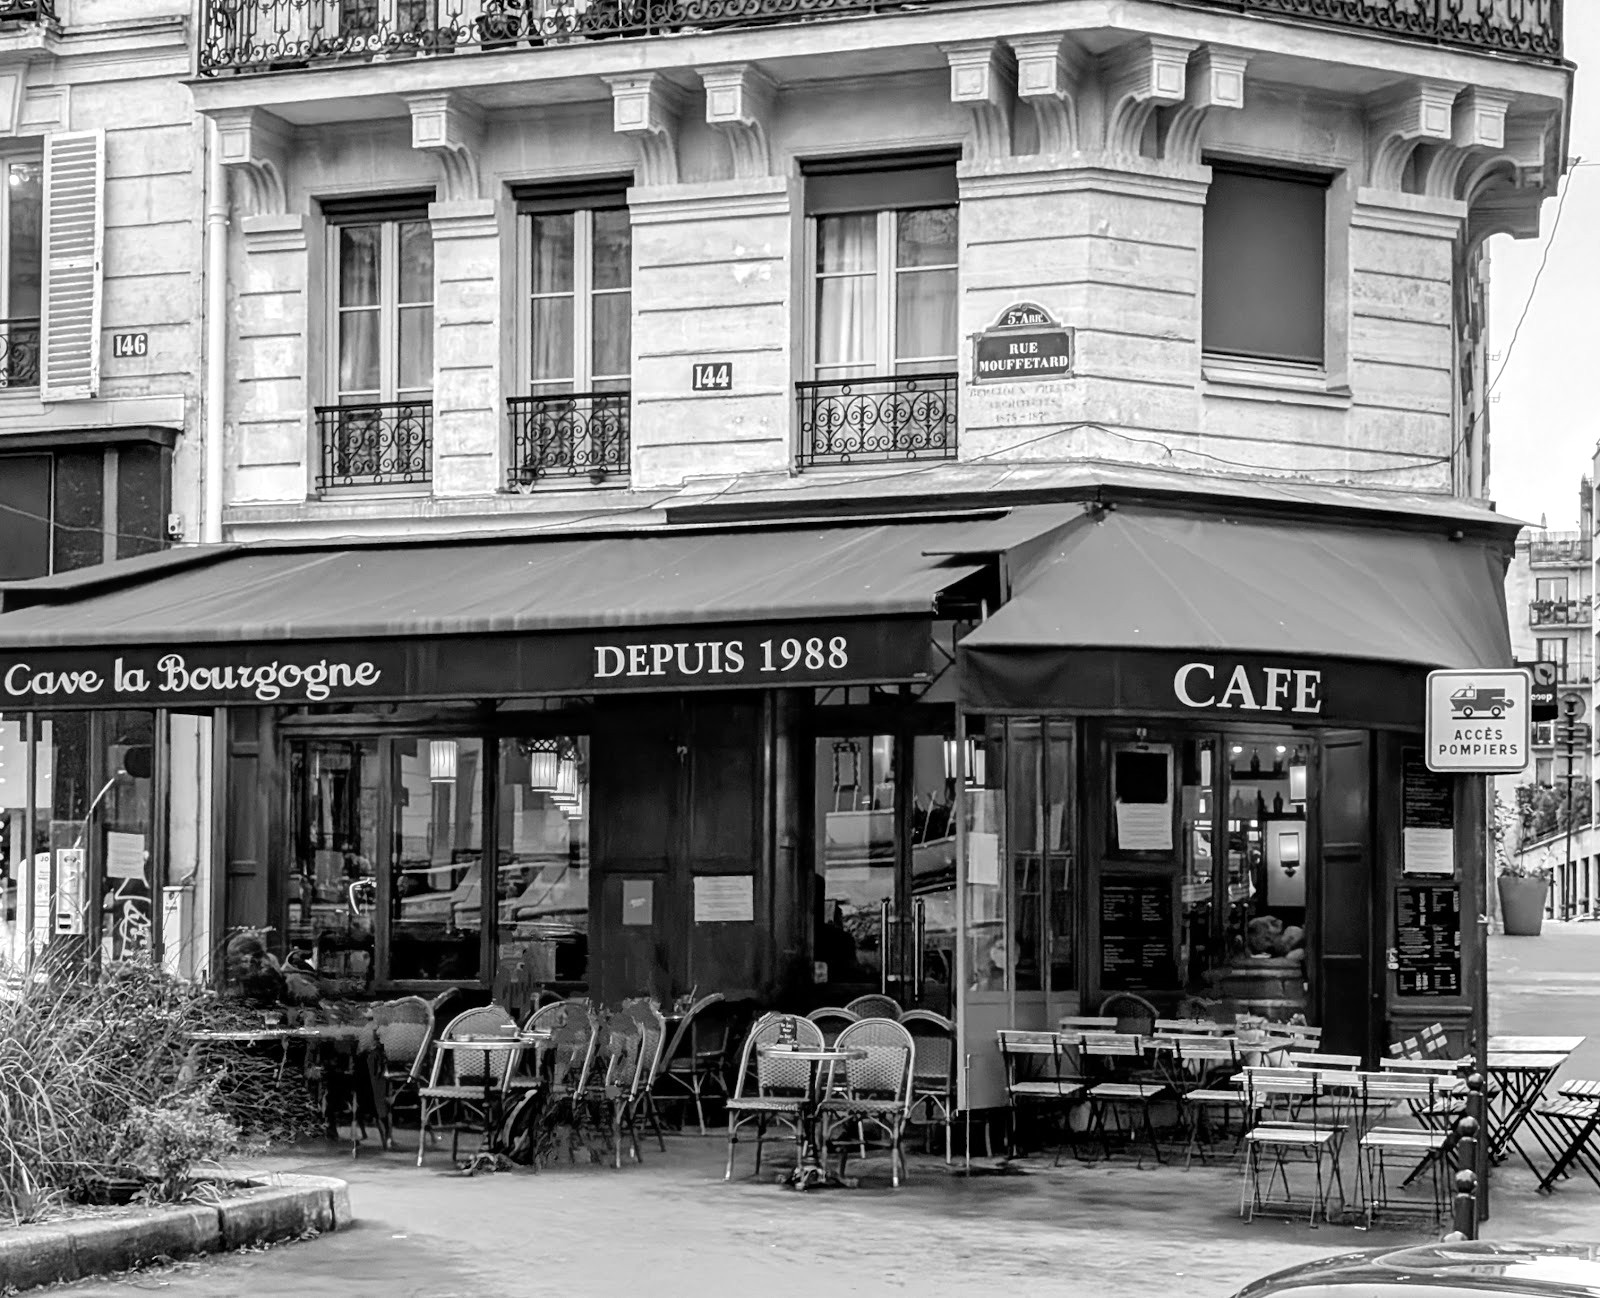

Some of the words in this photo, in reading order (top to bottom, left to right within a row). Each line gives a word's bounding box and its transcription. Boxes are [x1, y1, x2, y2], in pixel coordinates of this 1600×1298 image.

[115, 334, 146, 356] 146
[1009, 342, 1038, 355] RUE
[979, 355, 1068, 372] MOUFFETARD
[695, 365, 729, 388] 144
[593, 640, 745, 678] DEPUIS
[759, 636, 848, 672] 1988
[4, 663, 104, 696] Cave
[114, 658, 150, 692] la
[156, 653, 382, 701] Bourgogne
[1173, 662, 1322, 714] CAFE
[1454, 727, 1503, 740] ACCÈS
[1439, 744, 1518, 755] POMPIERS
